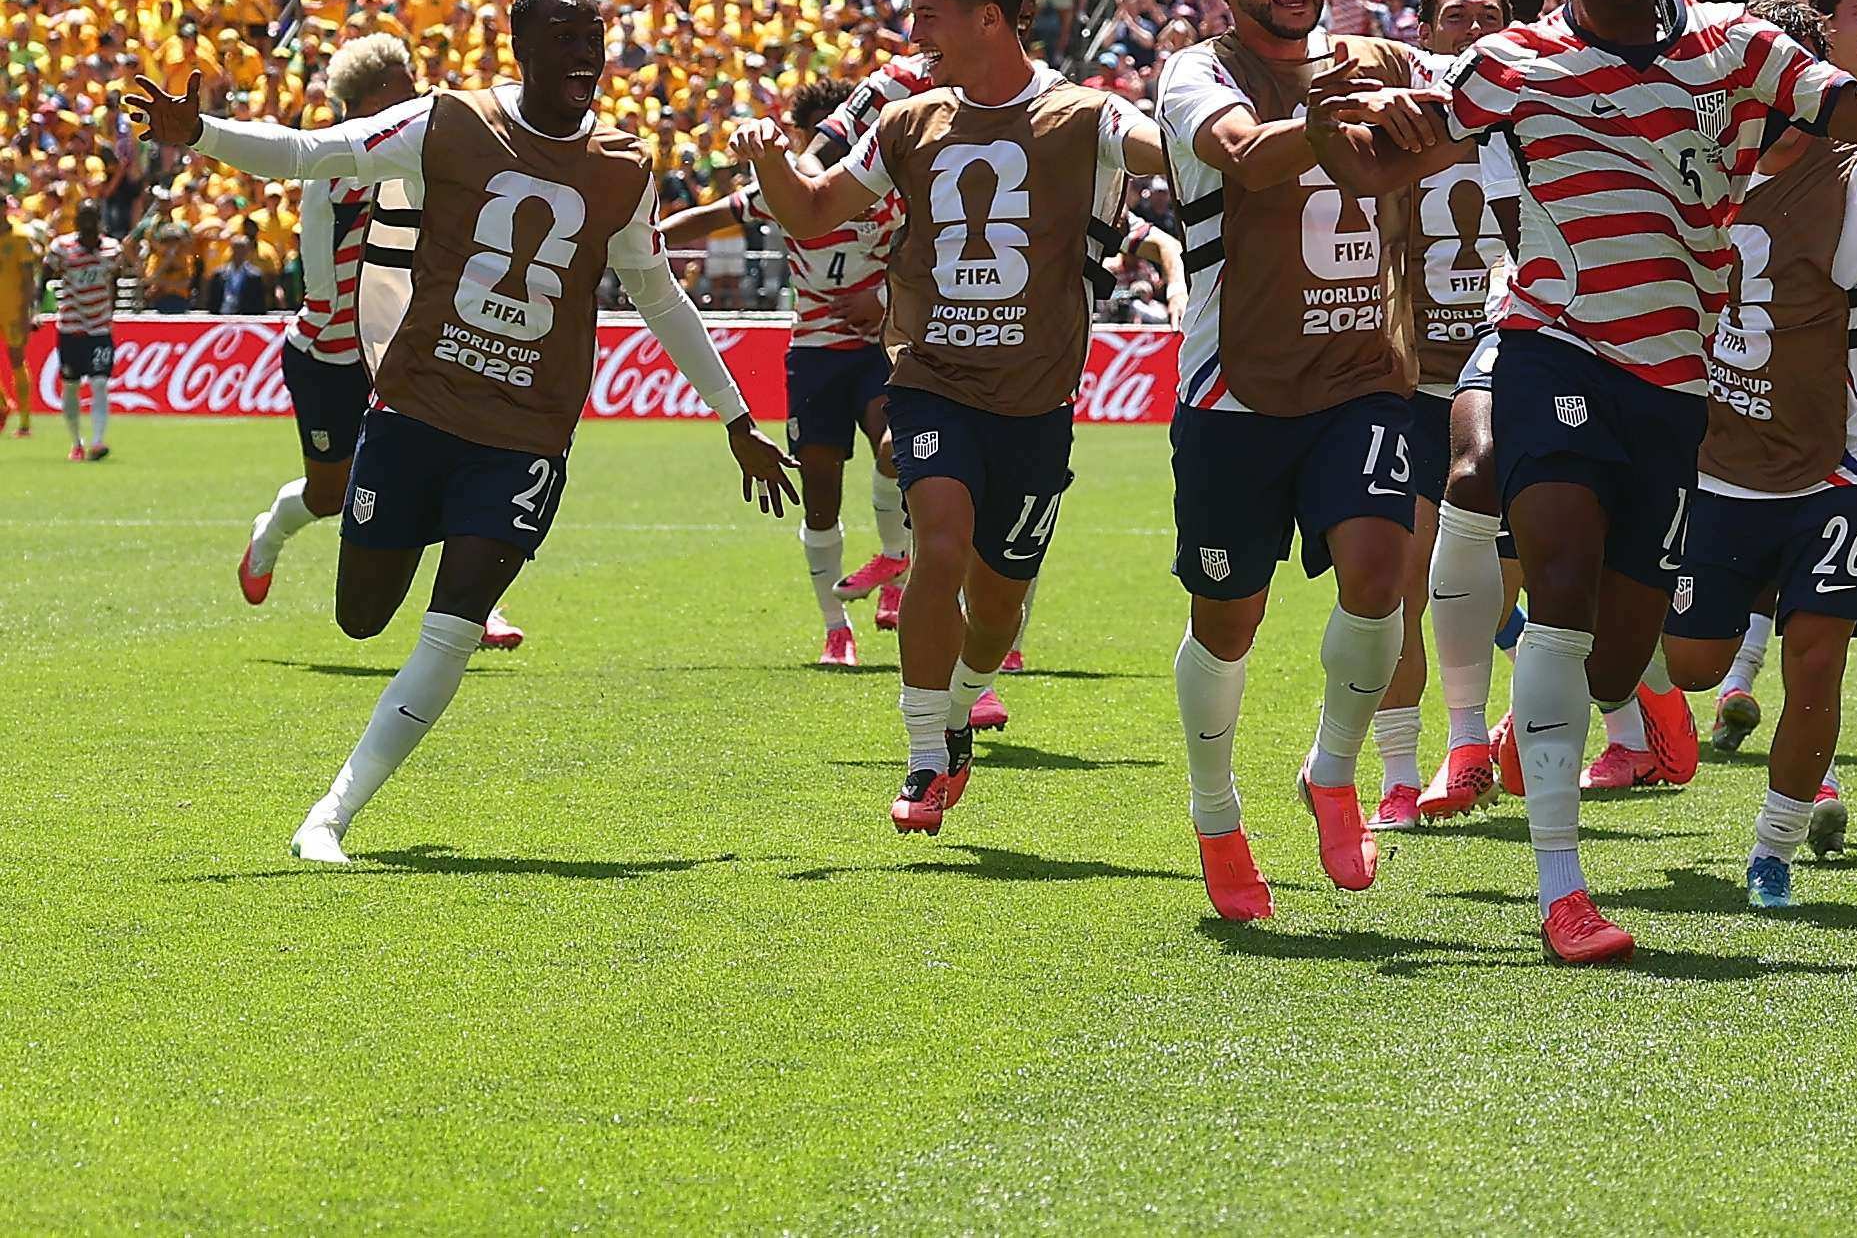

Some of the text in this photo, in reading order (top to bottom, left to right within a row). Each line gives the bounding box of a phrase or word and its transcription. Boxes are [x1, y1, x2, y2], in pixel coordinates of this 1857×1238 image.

[1695, 91, 1725, 114] USA
[1334, 241, 1375, 263] FIFA
[826, 251, 846, 286] 4
[954, 267, 1002, 286] FIFA
[1303, 286, 1370, 305] WORLD
[480, 298, 528, 328] FIFA
[931, 304, 1028, 321] WORLD CUP
[1425, 308, 1485, 320] WORLD
[441, 322, 541, 365] WORLD CUP
[924, 321, 1025, 347] 2026
[434, 338, 534, 388] 2026
[1741, 376, 1773, 395] CUP
[1556, 396, 1585, 410] USA
[914, 431, 938, 446] USA
[1362, 424, 1411, 483] 15
[356, 488, 375, 505] USA
[1005, 491, 1061, 546] 14
[1202, 547, 1227, 563] USA
